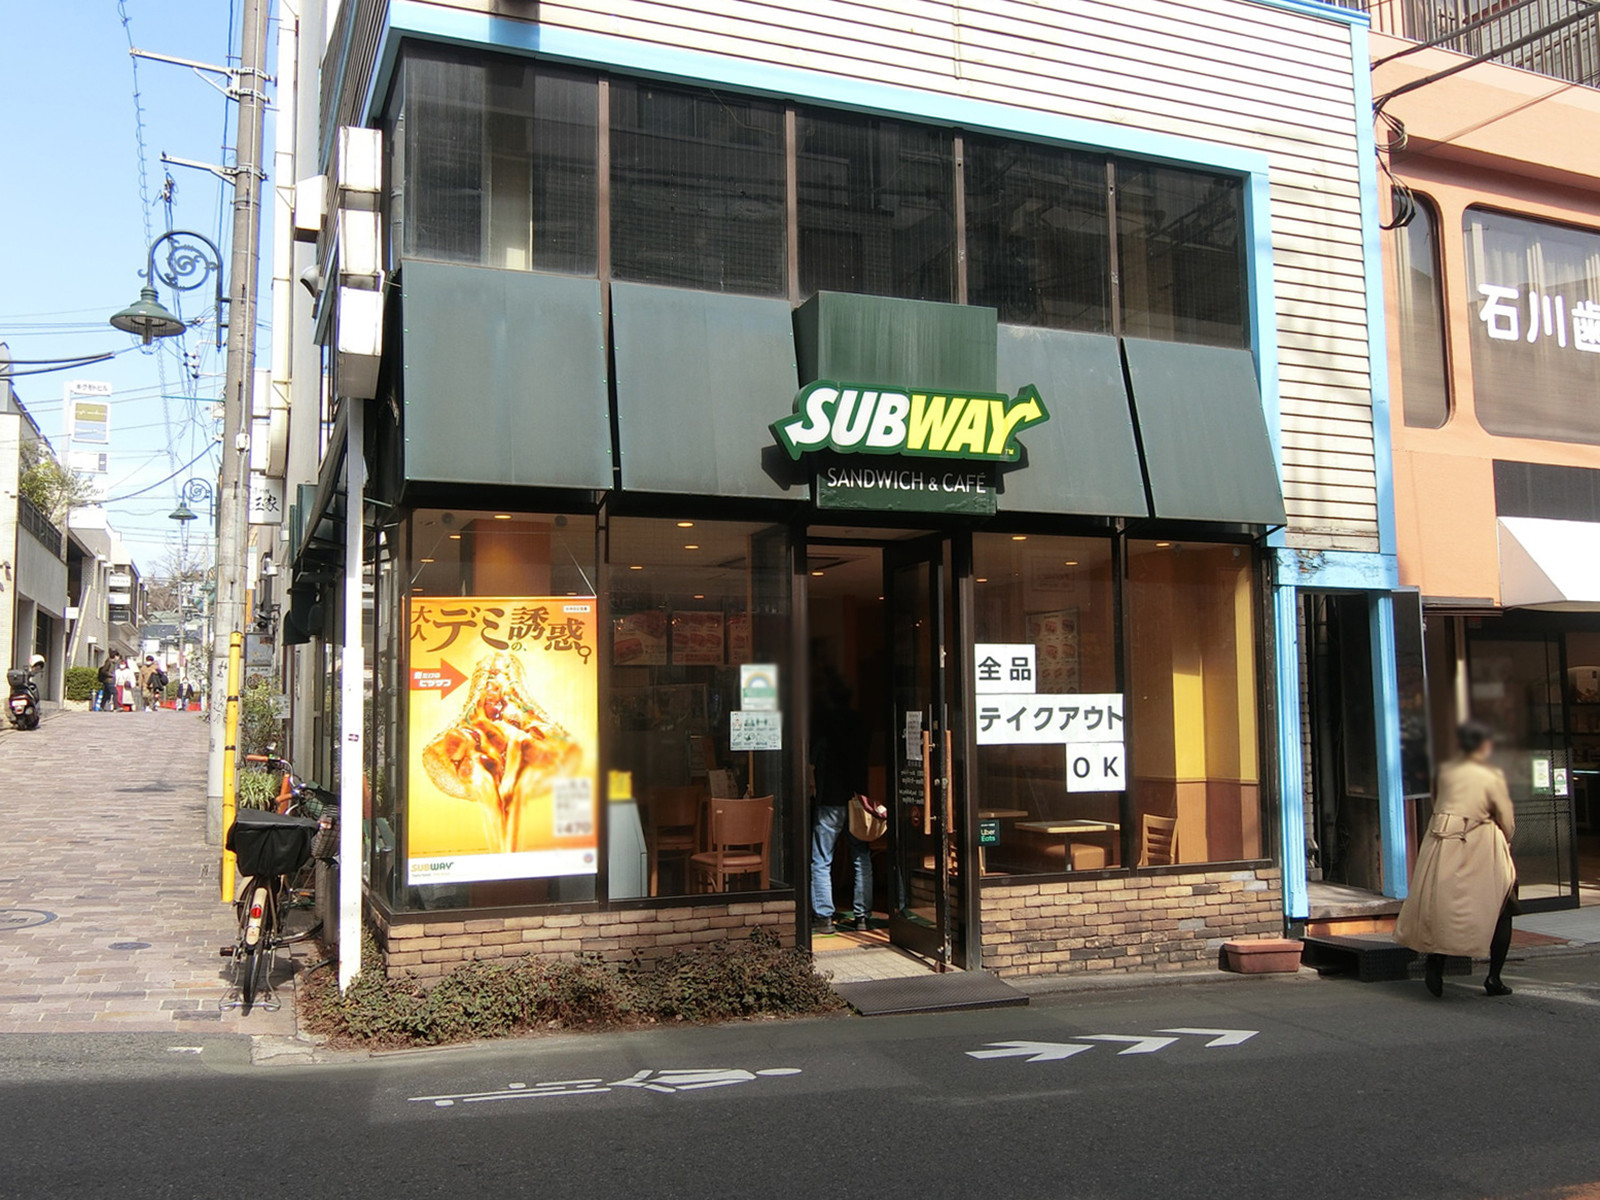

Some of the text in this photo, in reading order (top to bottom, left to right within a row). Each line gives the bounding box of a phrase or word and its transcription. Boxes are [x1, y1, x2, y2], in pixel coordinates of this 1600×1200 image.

[1477, 283, 1600, 353] 石川歯
[784, 387, 1042, 455] SUBWAY
[826, 467, 987, 494] SANDWICH & CAFÉ
[978, 656, 1032, 681] 全品
[979, 705, 1124, 732] テイクアウト
[410, 861, 455, 873] SUBWAY
